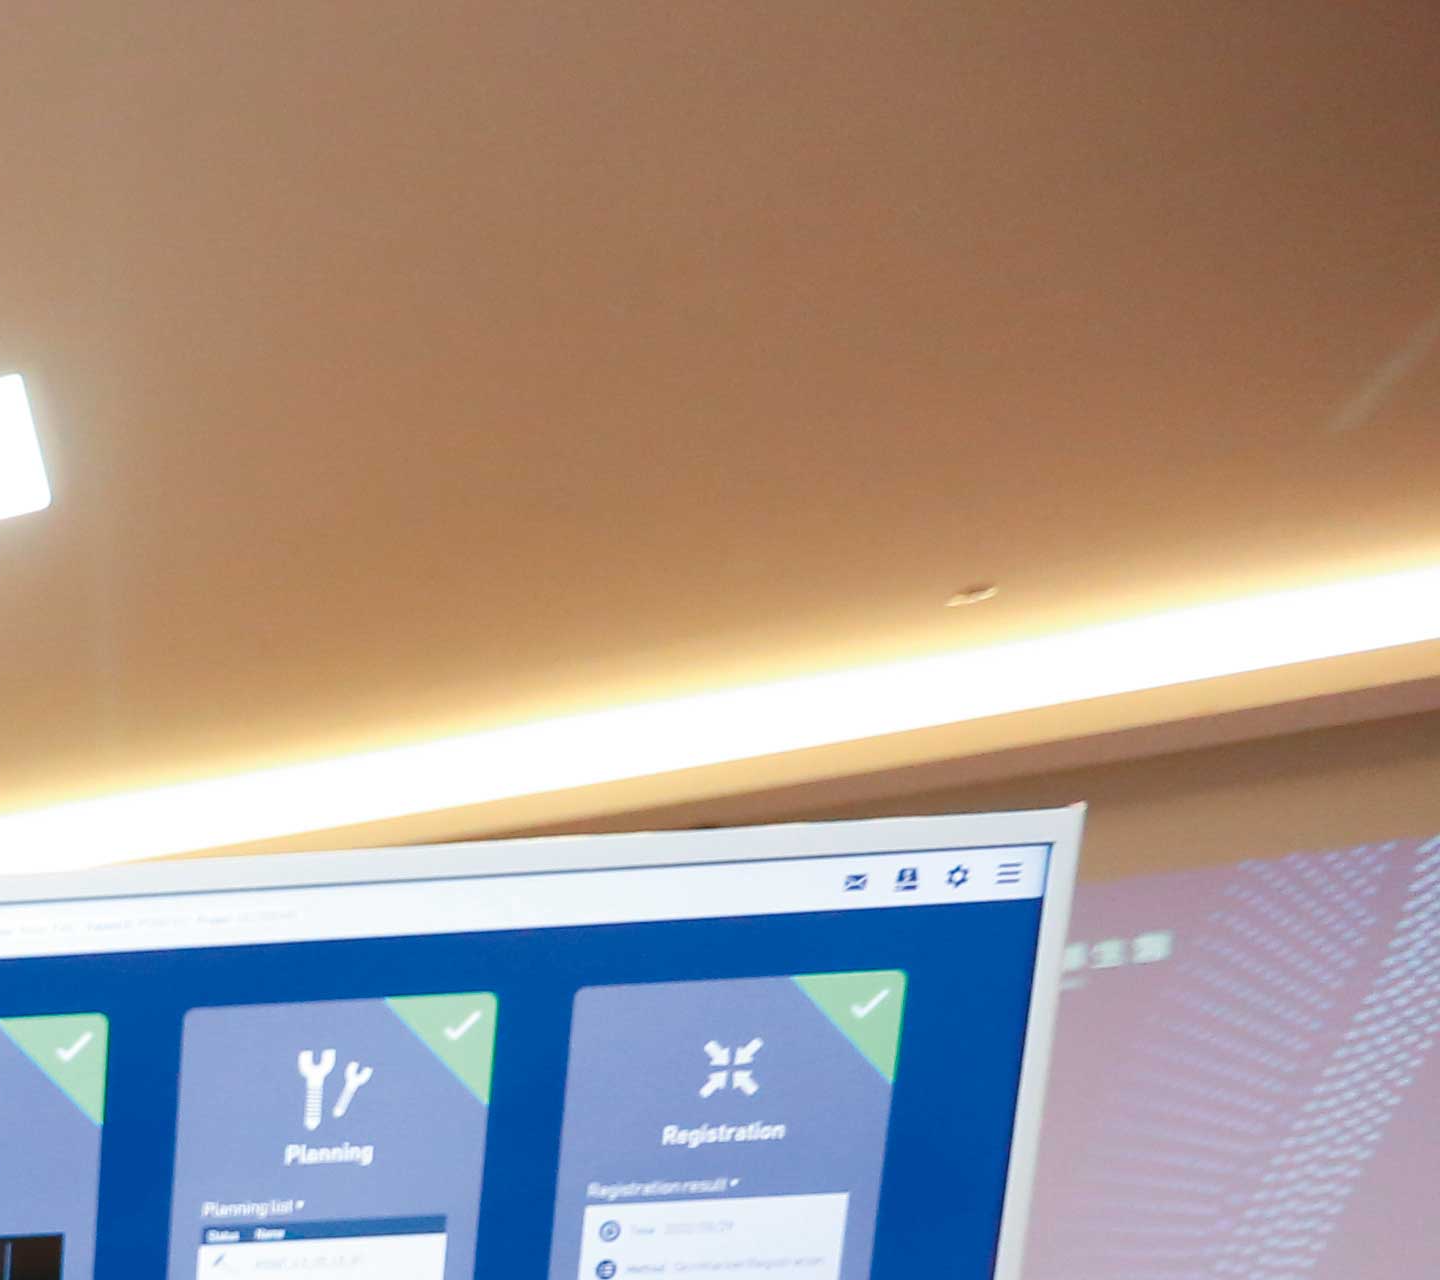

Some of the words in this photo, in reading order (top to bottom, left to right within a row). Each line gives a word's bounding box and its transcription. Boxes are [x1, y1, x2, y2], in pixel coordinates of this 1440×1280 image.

[662, 1120, 786, 1148] Registration
[284, 1142, 374, 1166] Planning
[201, 1201, 268, 1219] Planning
[271, 1199, 294, 1214] list
